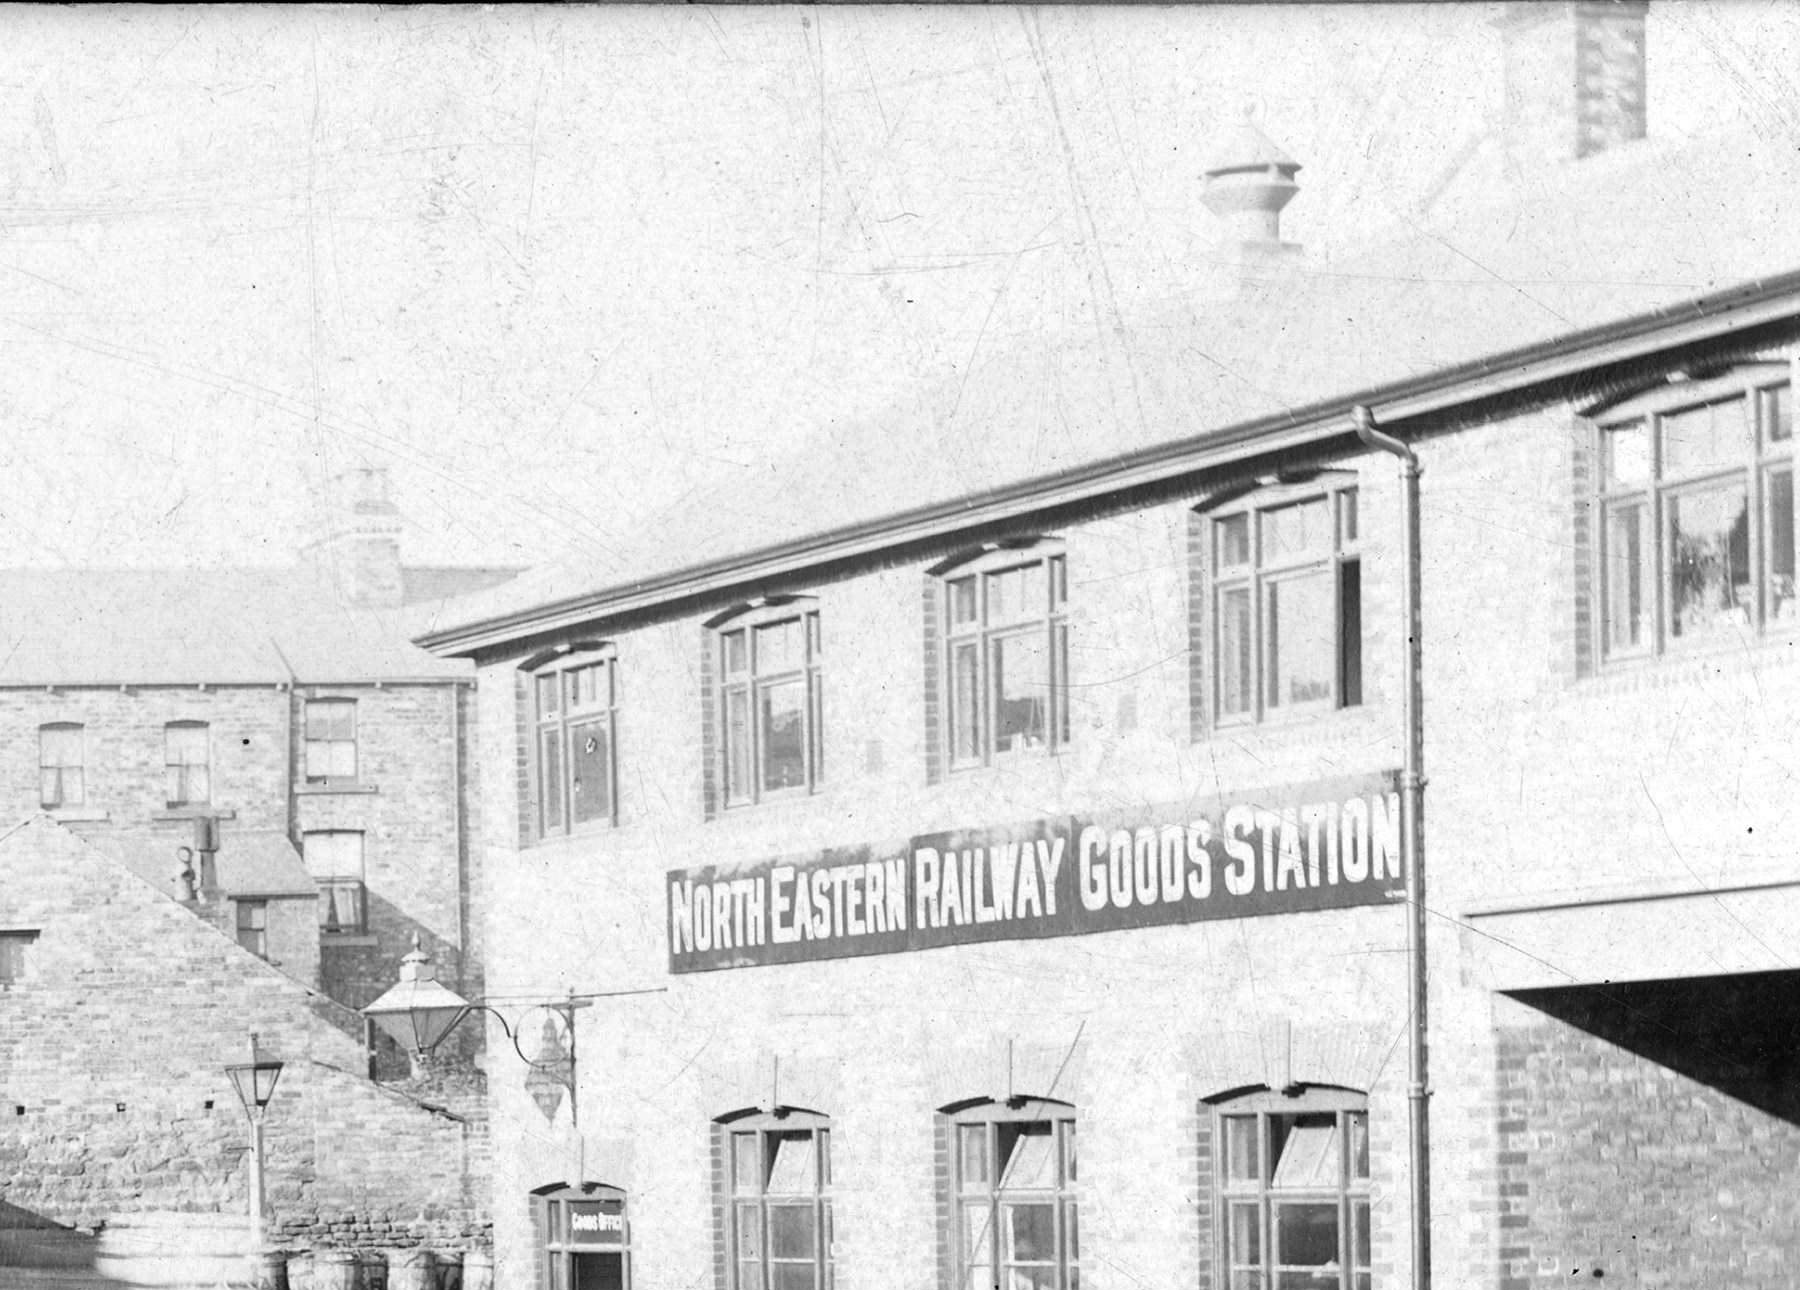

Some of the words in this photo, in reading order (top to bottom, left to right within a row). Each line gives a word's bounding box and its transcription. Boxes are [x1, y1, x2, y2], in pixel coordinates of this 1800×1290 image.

[672, 876, 765, 953] NORTH
[771, 858, 906, 943] EASTERN
[915, 837, 1064, 929] RAILWAY
[1079, 819, 1211, 911] GOODS
[1224, 791, 1400, 896] STATION
